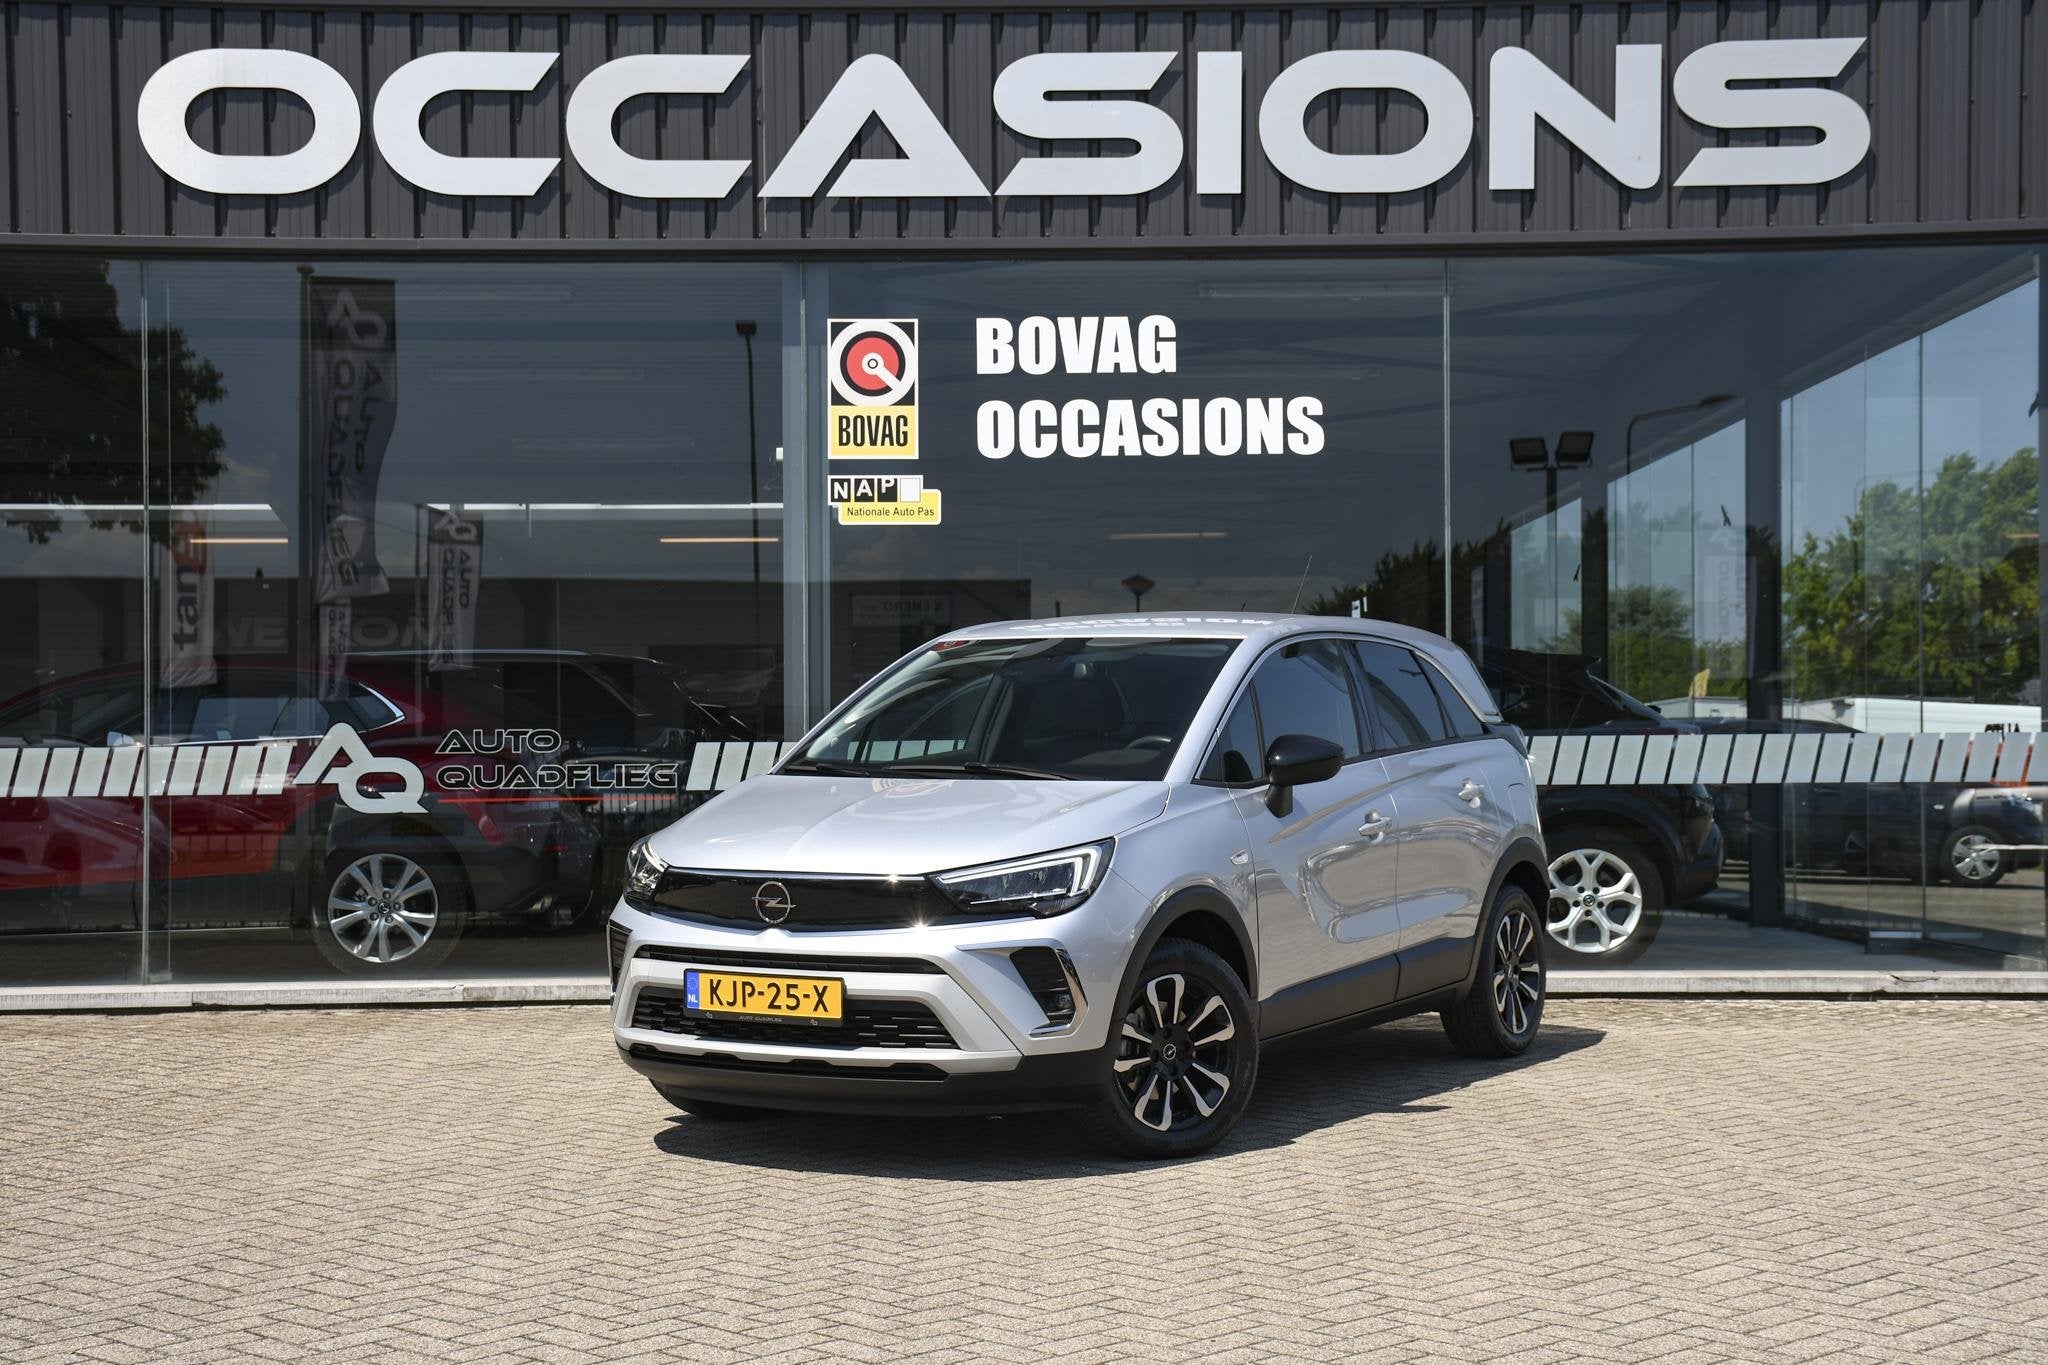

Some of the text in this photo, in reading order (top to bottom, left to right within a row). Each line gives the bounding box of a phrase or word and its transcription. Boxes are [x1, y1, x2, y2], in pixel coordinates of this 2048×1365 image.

[137, 37, 1871, 197] OCCASIONS
[976, 315, 1177, 374] BOVAG
[838, 414, 908, 447] BOVAG
[976, 396, 1325, 459] OCCASIONS
[833, 478, 896, 500] NAP
[847, 507, 935, 516] Nationale Auto Pas
[435, 729, 561, 753] AUTO
[294, 722, 429, 814] AQ
[436, 763, 678, 790] QUADFLIEG
[688, 978, 829, 1013] NL KJP-25-X
